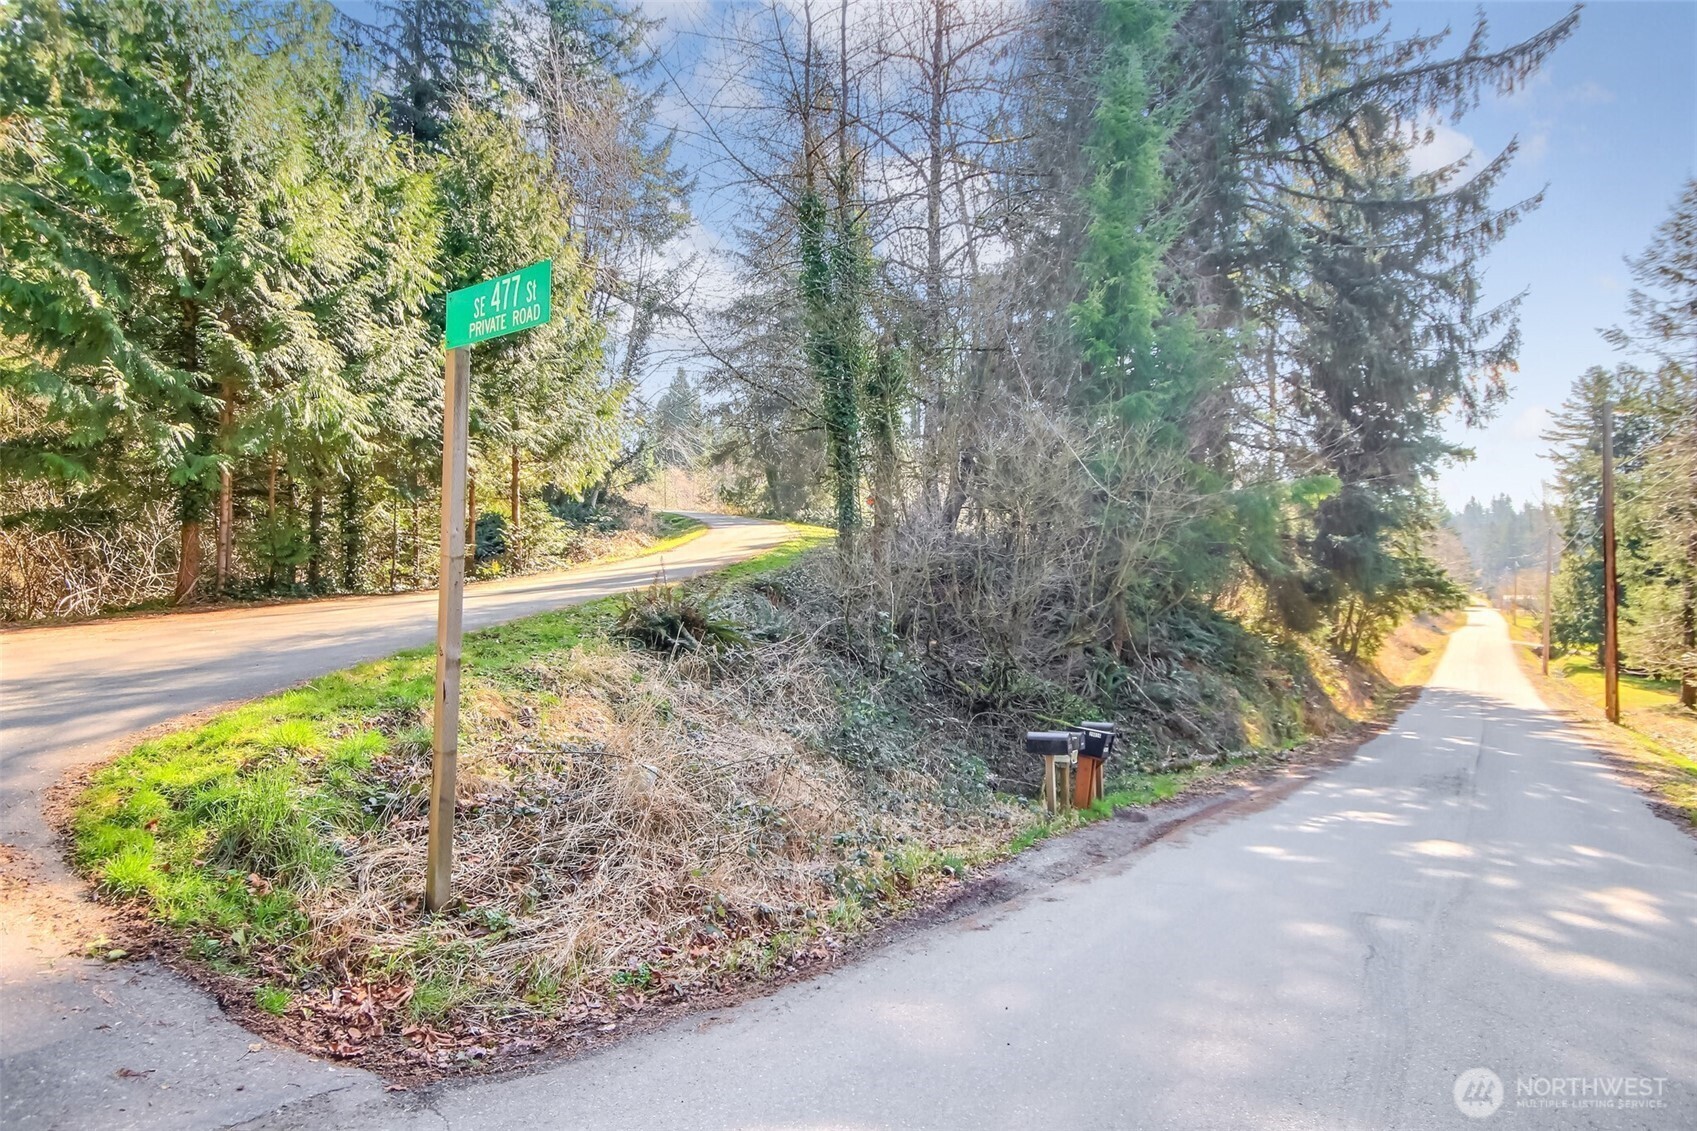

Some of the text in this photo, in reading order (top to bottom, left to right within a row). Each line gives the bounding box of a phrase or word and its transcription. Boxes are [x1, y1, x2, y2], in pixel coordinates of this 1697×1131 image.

[473, 274, 537, 318] SE 477 St
[469, 303, 541, 339] PRIVATE ROAD
